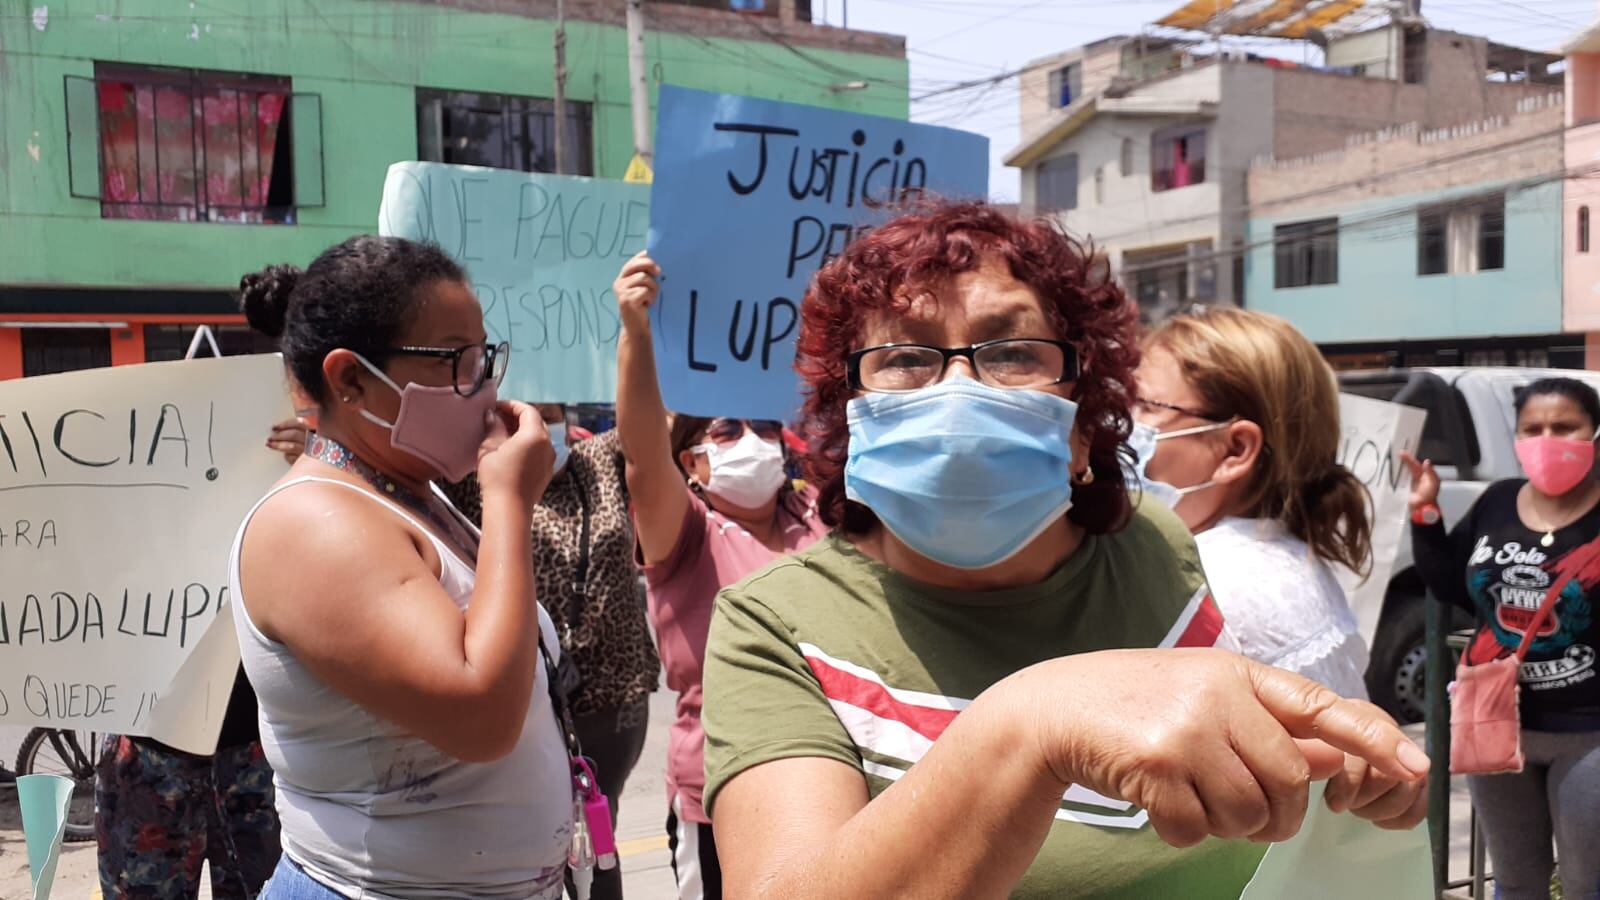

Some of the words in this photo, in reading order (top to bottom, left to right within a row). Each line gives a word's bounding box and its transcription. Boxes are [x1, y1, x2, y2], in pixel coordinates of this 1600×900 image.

[386, 168, 489, 261] QUE
[514, 183, 648, 262] PAGUE
[24, 674, 117, 720] QUEDE
